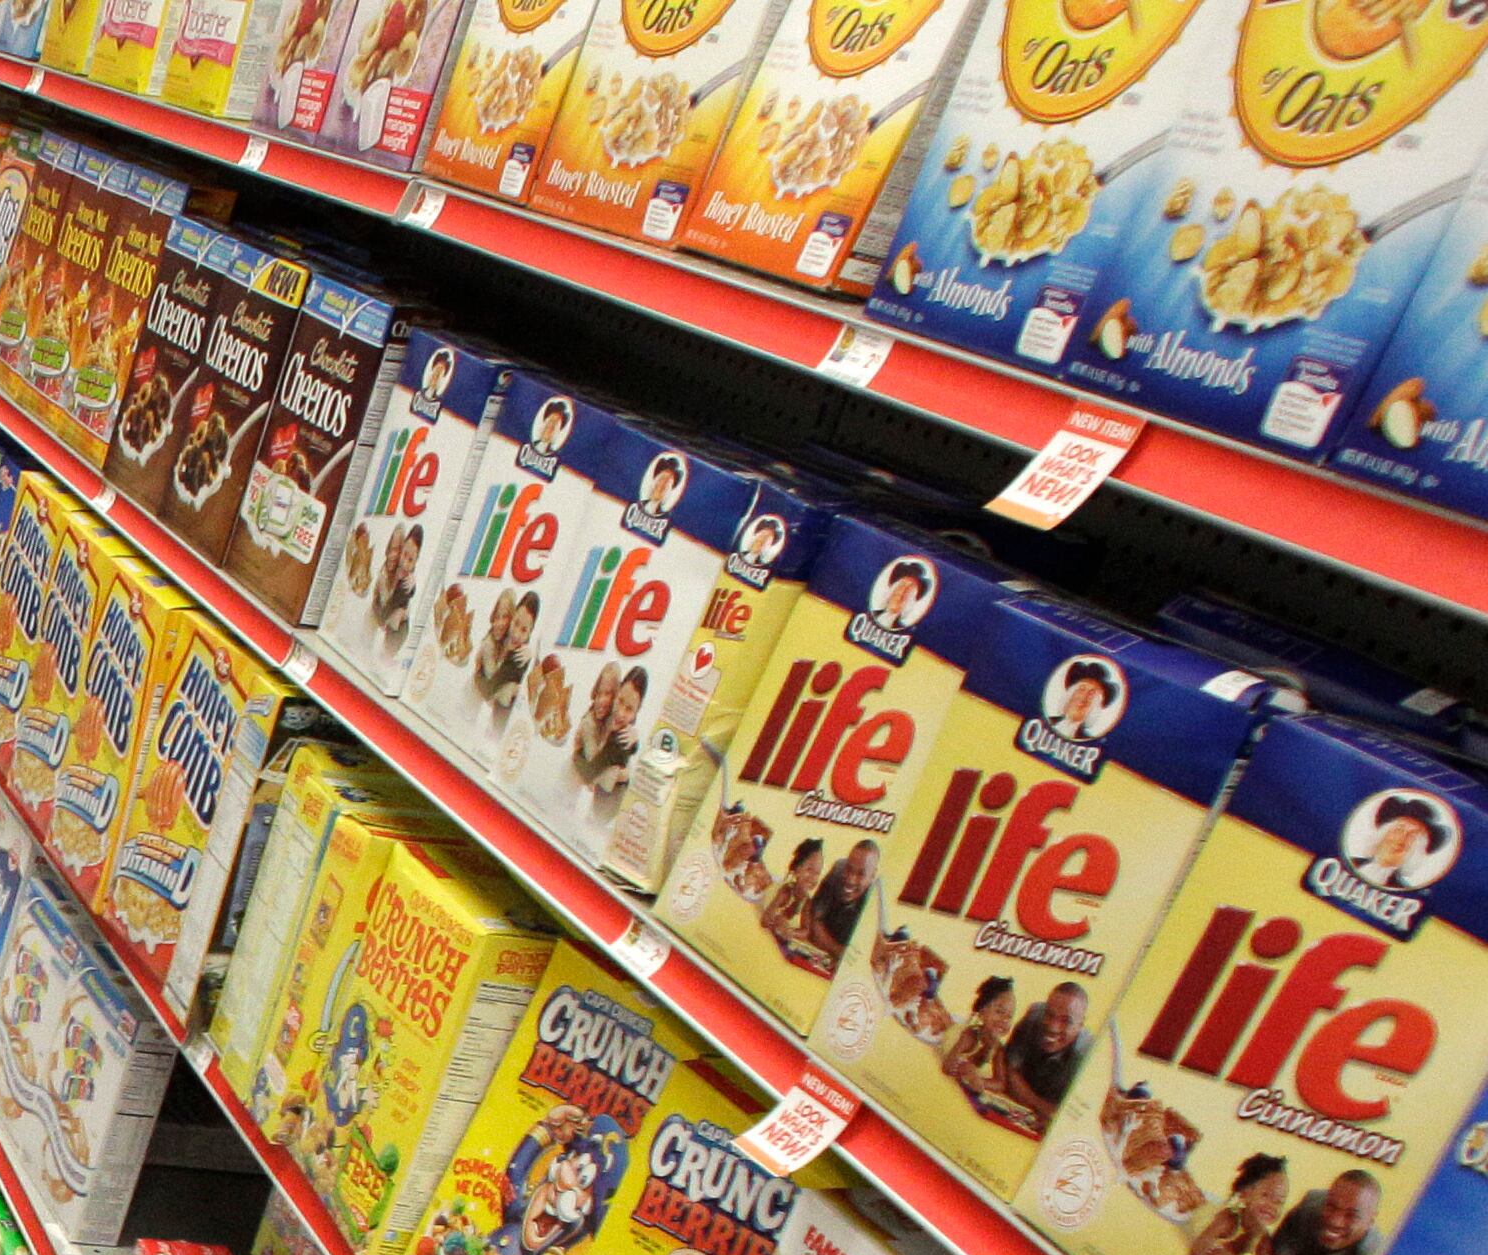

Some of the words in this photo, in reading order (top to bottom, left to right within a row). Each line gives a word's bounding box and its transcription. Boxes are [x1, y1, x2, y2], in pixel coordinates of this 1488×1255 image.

[643, 3, 695, 34] Oats
[830, 7, 893, 53] Oats
[1022, 37, 1038, 61] of
[1032, 43, 1106, 94] Oats
[1262, 65, 1285, 91] of
[1277, 78, 1379, 128] Oats
[547, 161, 583, 200] Honey
[586, 171, 641, 208] Roasted
[704, 192, 741, 231] Honey
[743, 203, 805, 242] Roasted
[58, 214, 104, 271] Cheerios
[106, 237, 156, 297] Cheerios
[147, 283, 205, 355] Cheerios
[914, 270, 932, 287] with
[930, 272, 1013, 320] Almonds
[1127, 331, 1154, 353] with
[1152, 331, 1256, 395] Almonds
[1070, 411, 1102, 432] NEW
[1102, 419, 1137, 441] ITEM!
[1420, 420, 1460, 441] with
[366, 428, 439, 516] life
[520, 445, 556, 478] QUAKER
[1040, 456, 1096, 484] WHAT'S
[1061, 442, 1106, 466] LOOK
[1019, 472, 1082, 506] NEW!
[459, 482, 557, 582] life
[702, 588, 751, 634] life
[852, 616, 911, 661] QUAKER
[1025, 719, 1100, 772] QUAKER
[795, 791, 893, 833] Cinnamon
[899, 767, 1119, 941] life
[369, 883, 470, 988] CRUNCH
[974, 921, 1104, 976] Cinnamon
[1138, 907, 1438, 1122] life
[537, 992, 674, 1104] CRUNCH
[521, 1044, 652, 1138] BERRIES
[802, 1072, 829, 1096] NEW
[793, 1099, 827, 1126] LOOK
